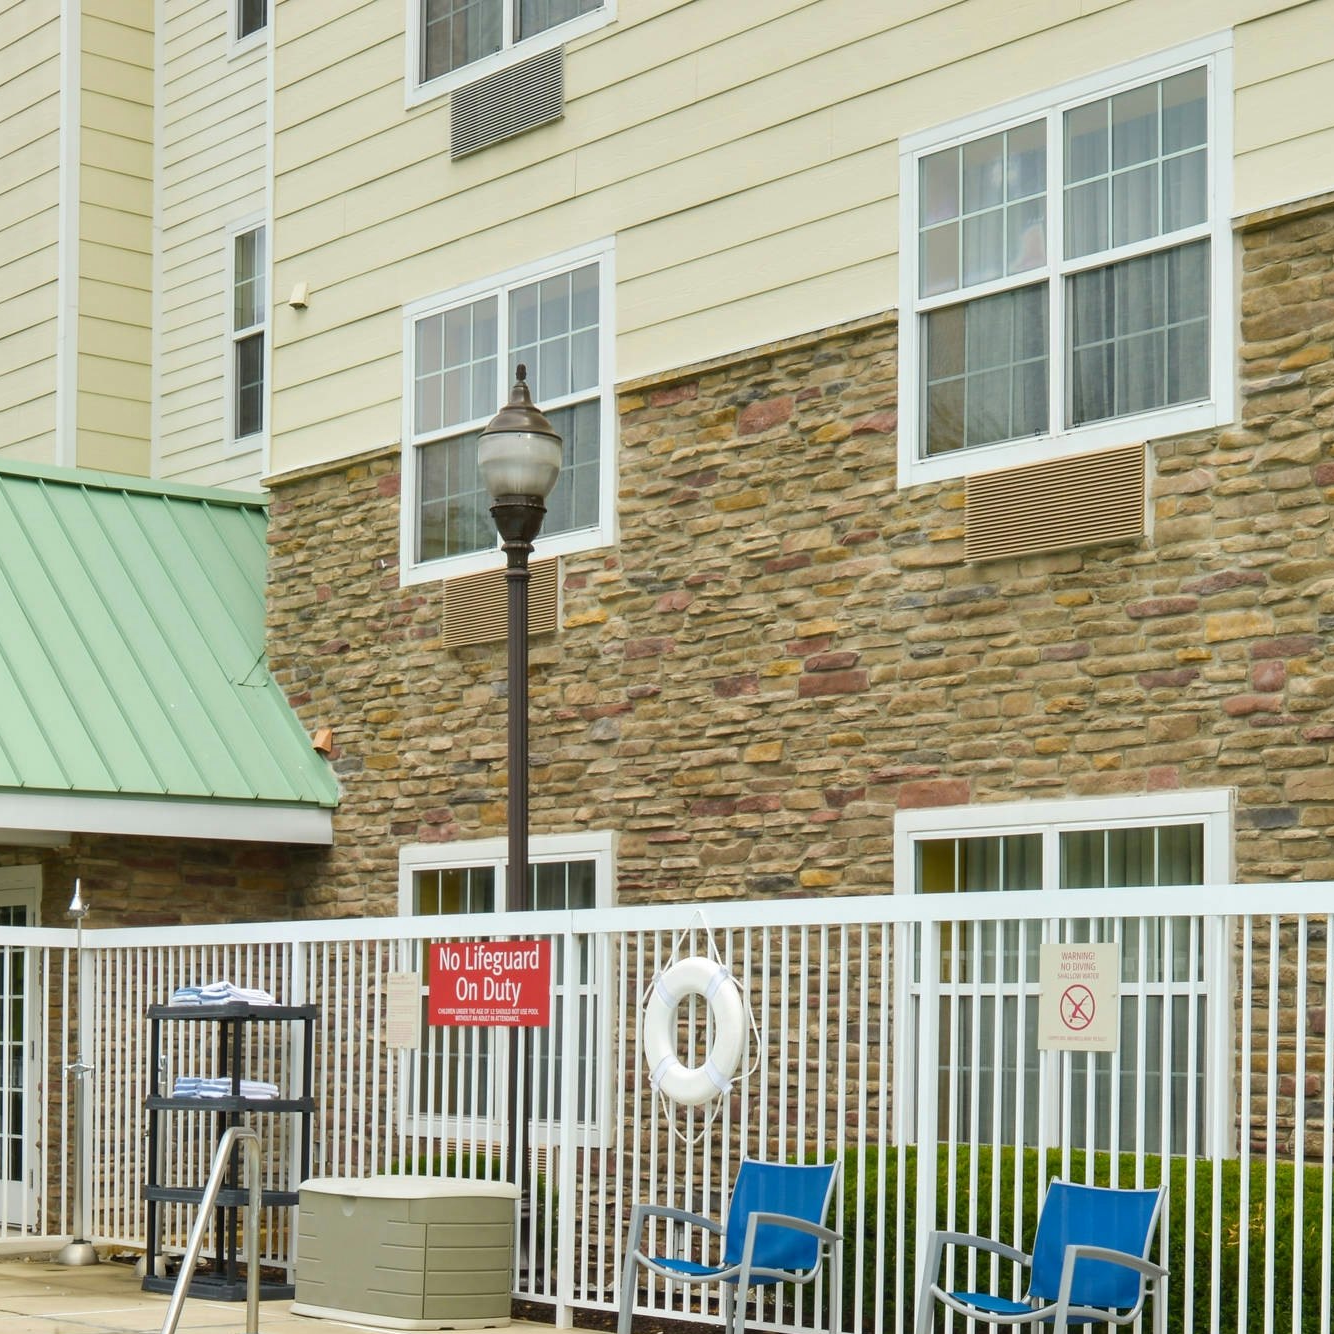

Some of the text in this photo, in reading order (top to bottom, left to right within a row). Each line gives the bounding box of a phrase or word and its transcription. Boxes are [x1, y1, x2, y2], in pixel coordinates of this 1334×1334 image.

[439, 944, 539, 976] No Lifeguard
[1061, 952, 1096, 960] WARNING!
[1060, 963, 1097, 971] NO DIVING
[455, 976, 522, 1007] On Duty
